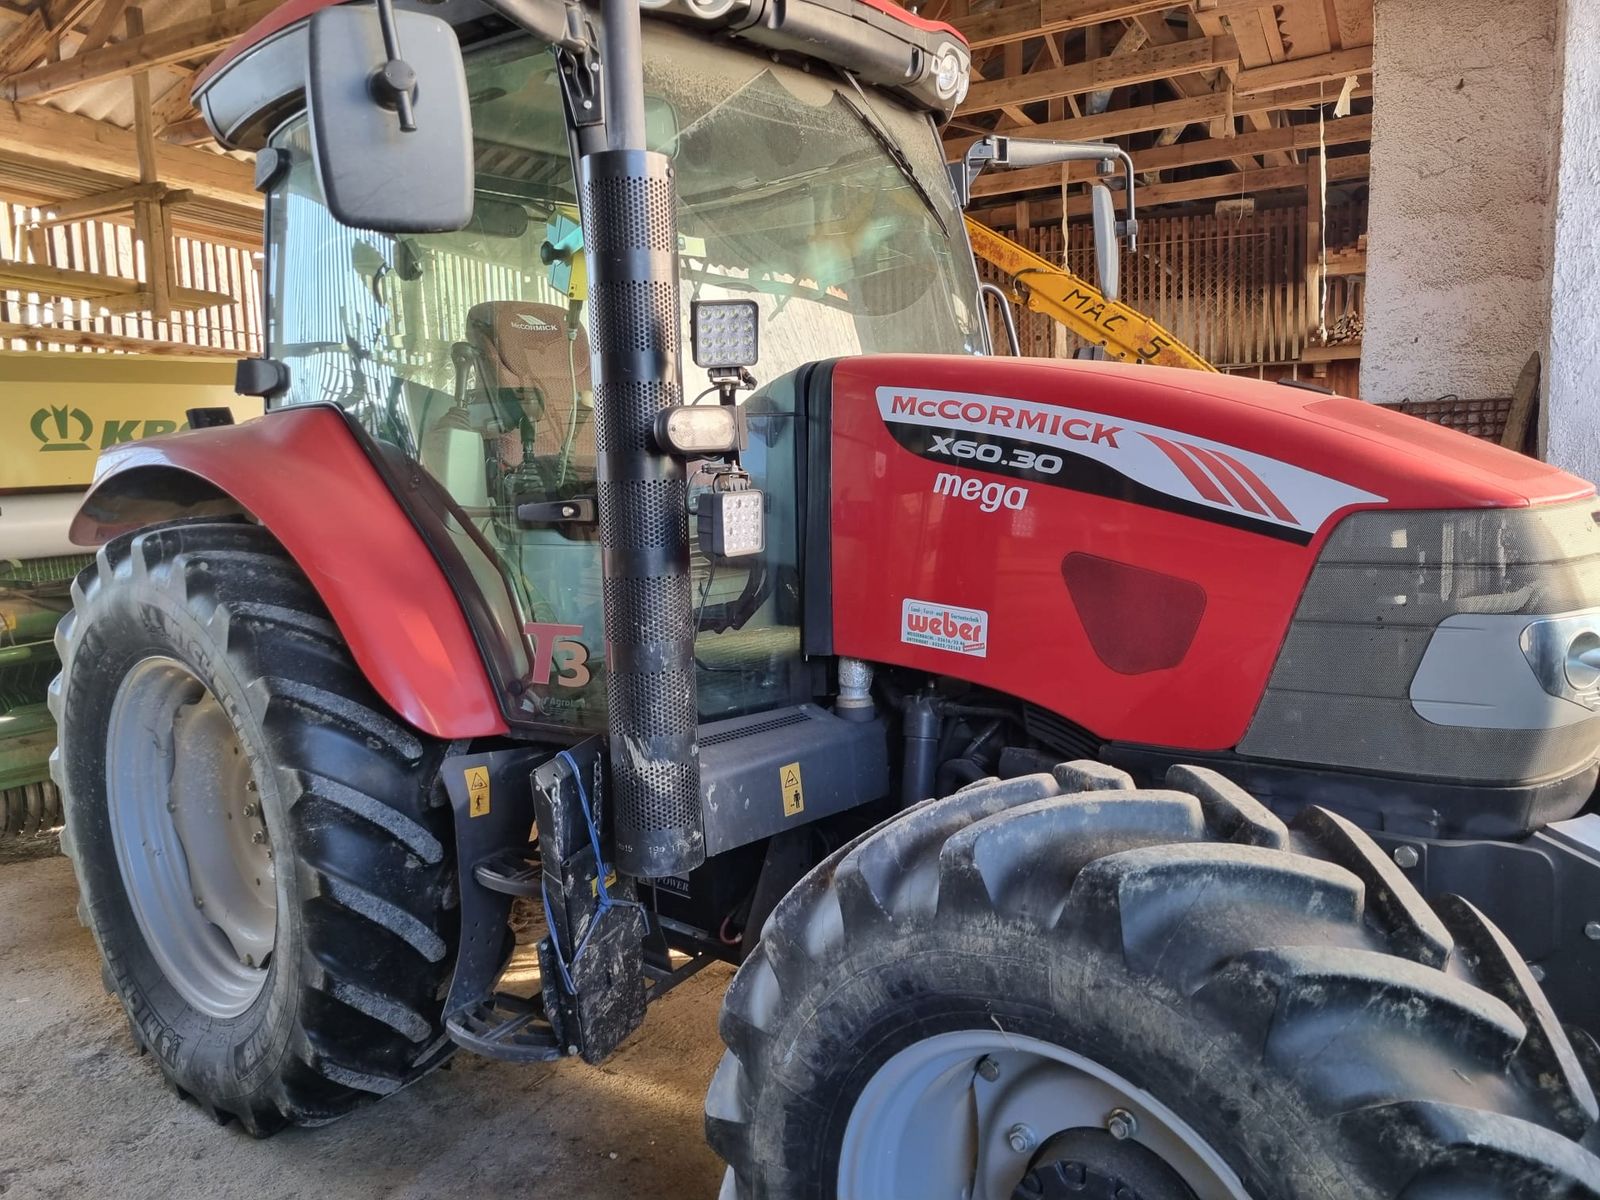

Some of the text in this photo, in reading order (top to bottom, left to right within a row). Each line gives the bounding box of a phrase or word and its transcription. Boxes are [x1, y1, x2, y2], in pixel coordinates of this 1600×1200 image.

[1062, 289, 1171, 359] MAC 5
[891, 395, 1124, 449] McCORMICK
[927, 435, 1063, 475] X60.30
[933, 472, 1029, 513] mega
[908, 611, 981, 642] weber
